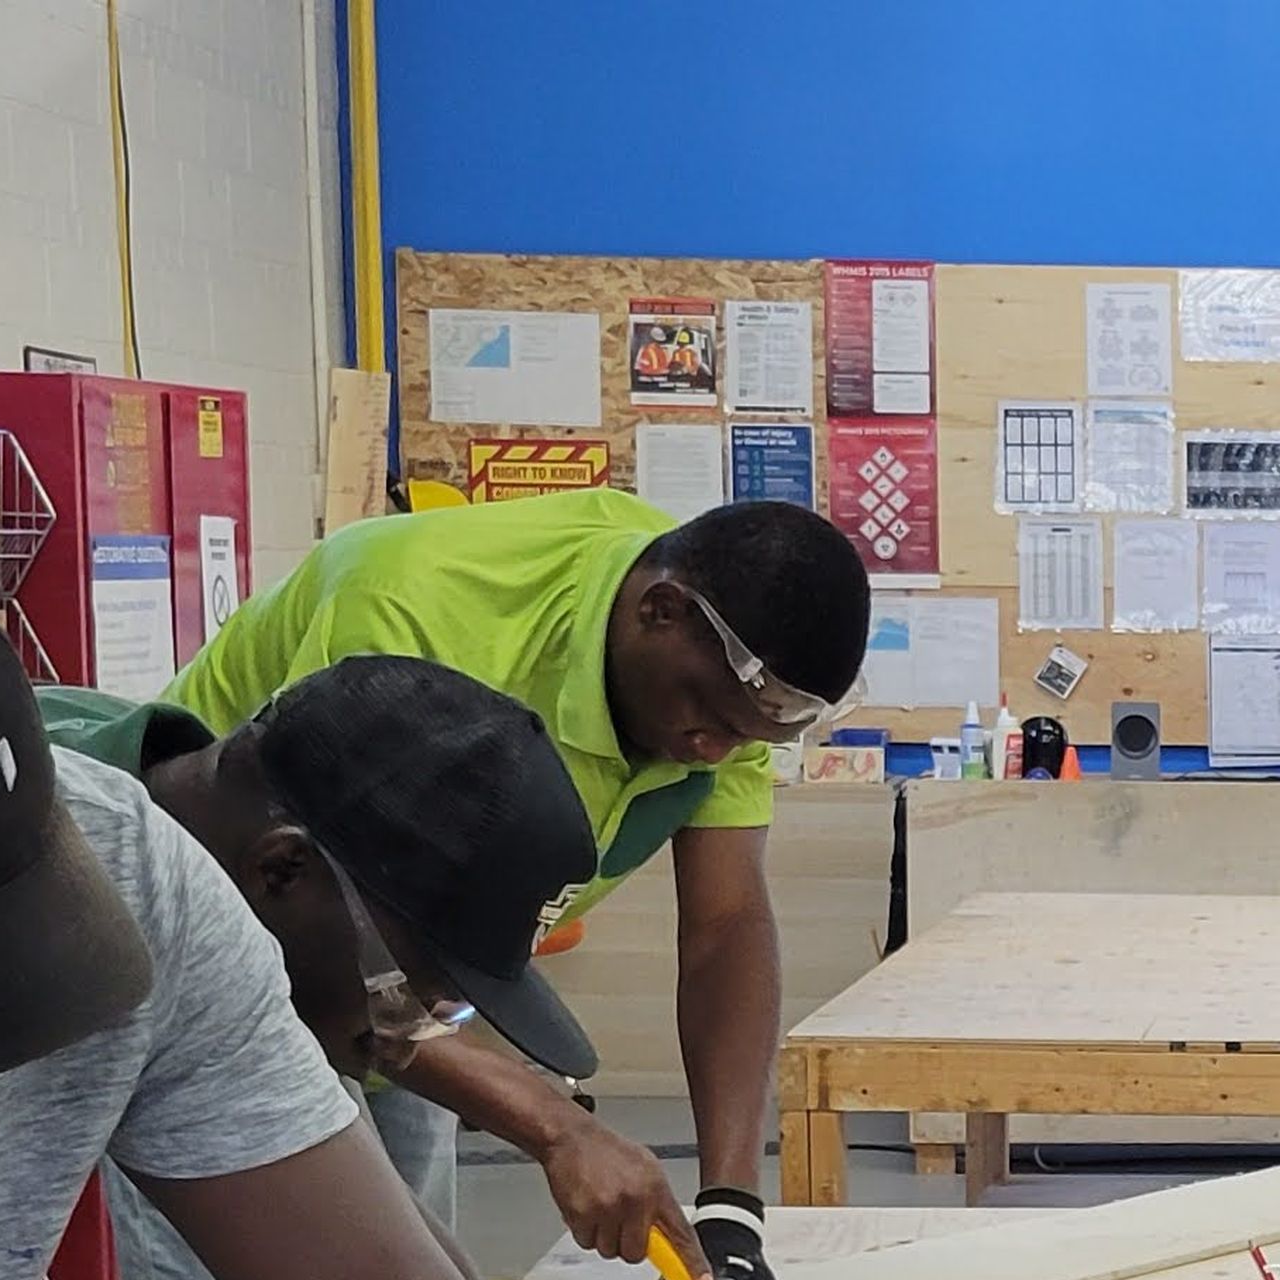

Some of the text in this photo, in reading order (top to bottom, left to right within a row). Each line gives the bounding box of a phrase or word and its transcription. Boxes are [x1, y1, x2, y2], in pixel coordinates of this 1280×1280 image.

[492, 466, 588, 480] RIGHT TO KNOW
